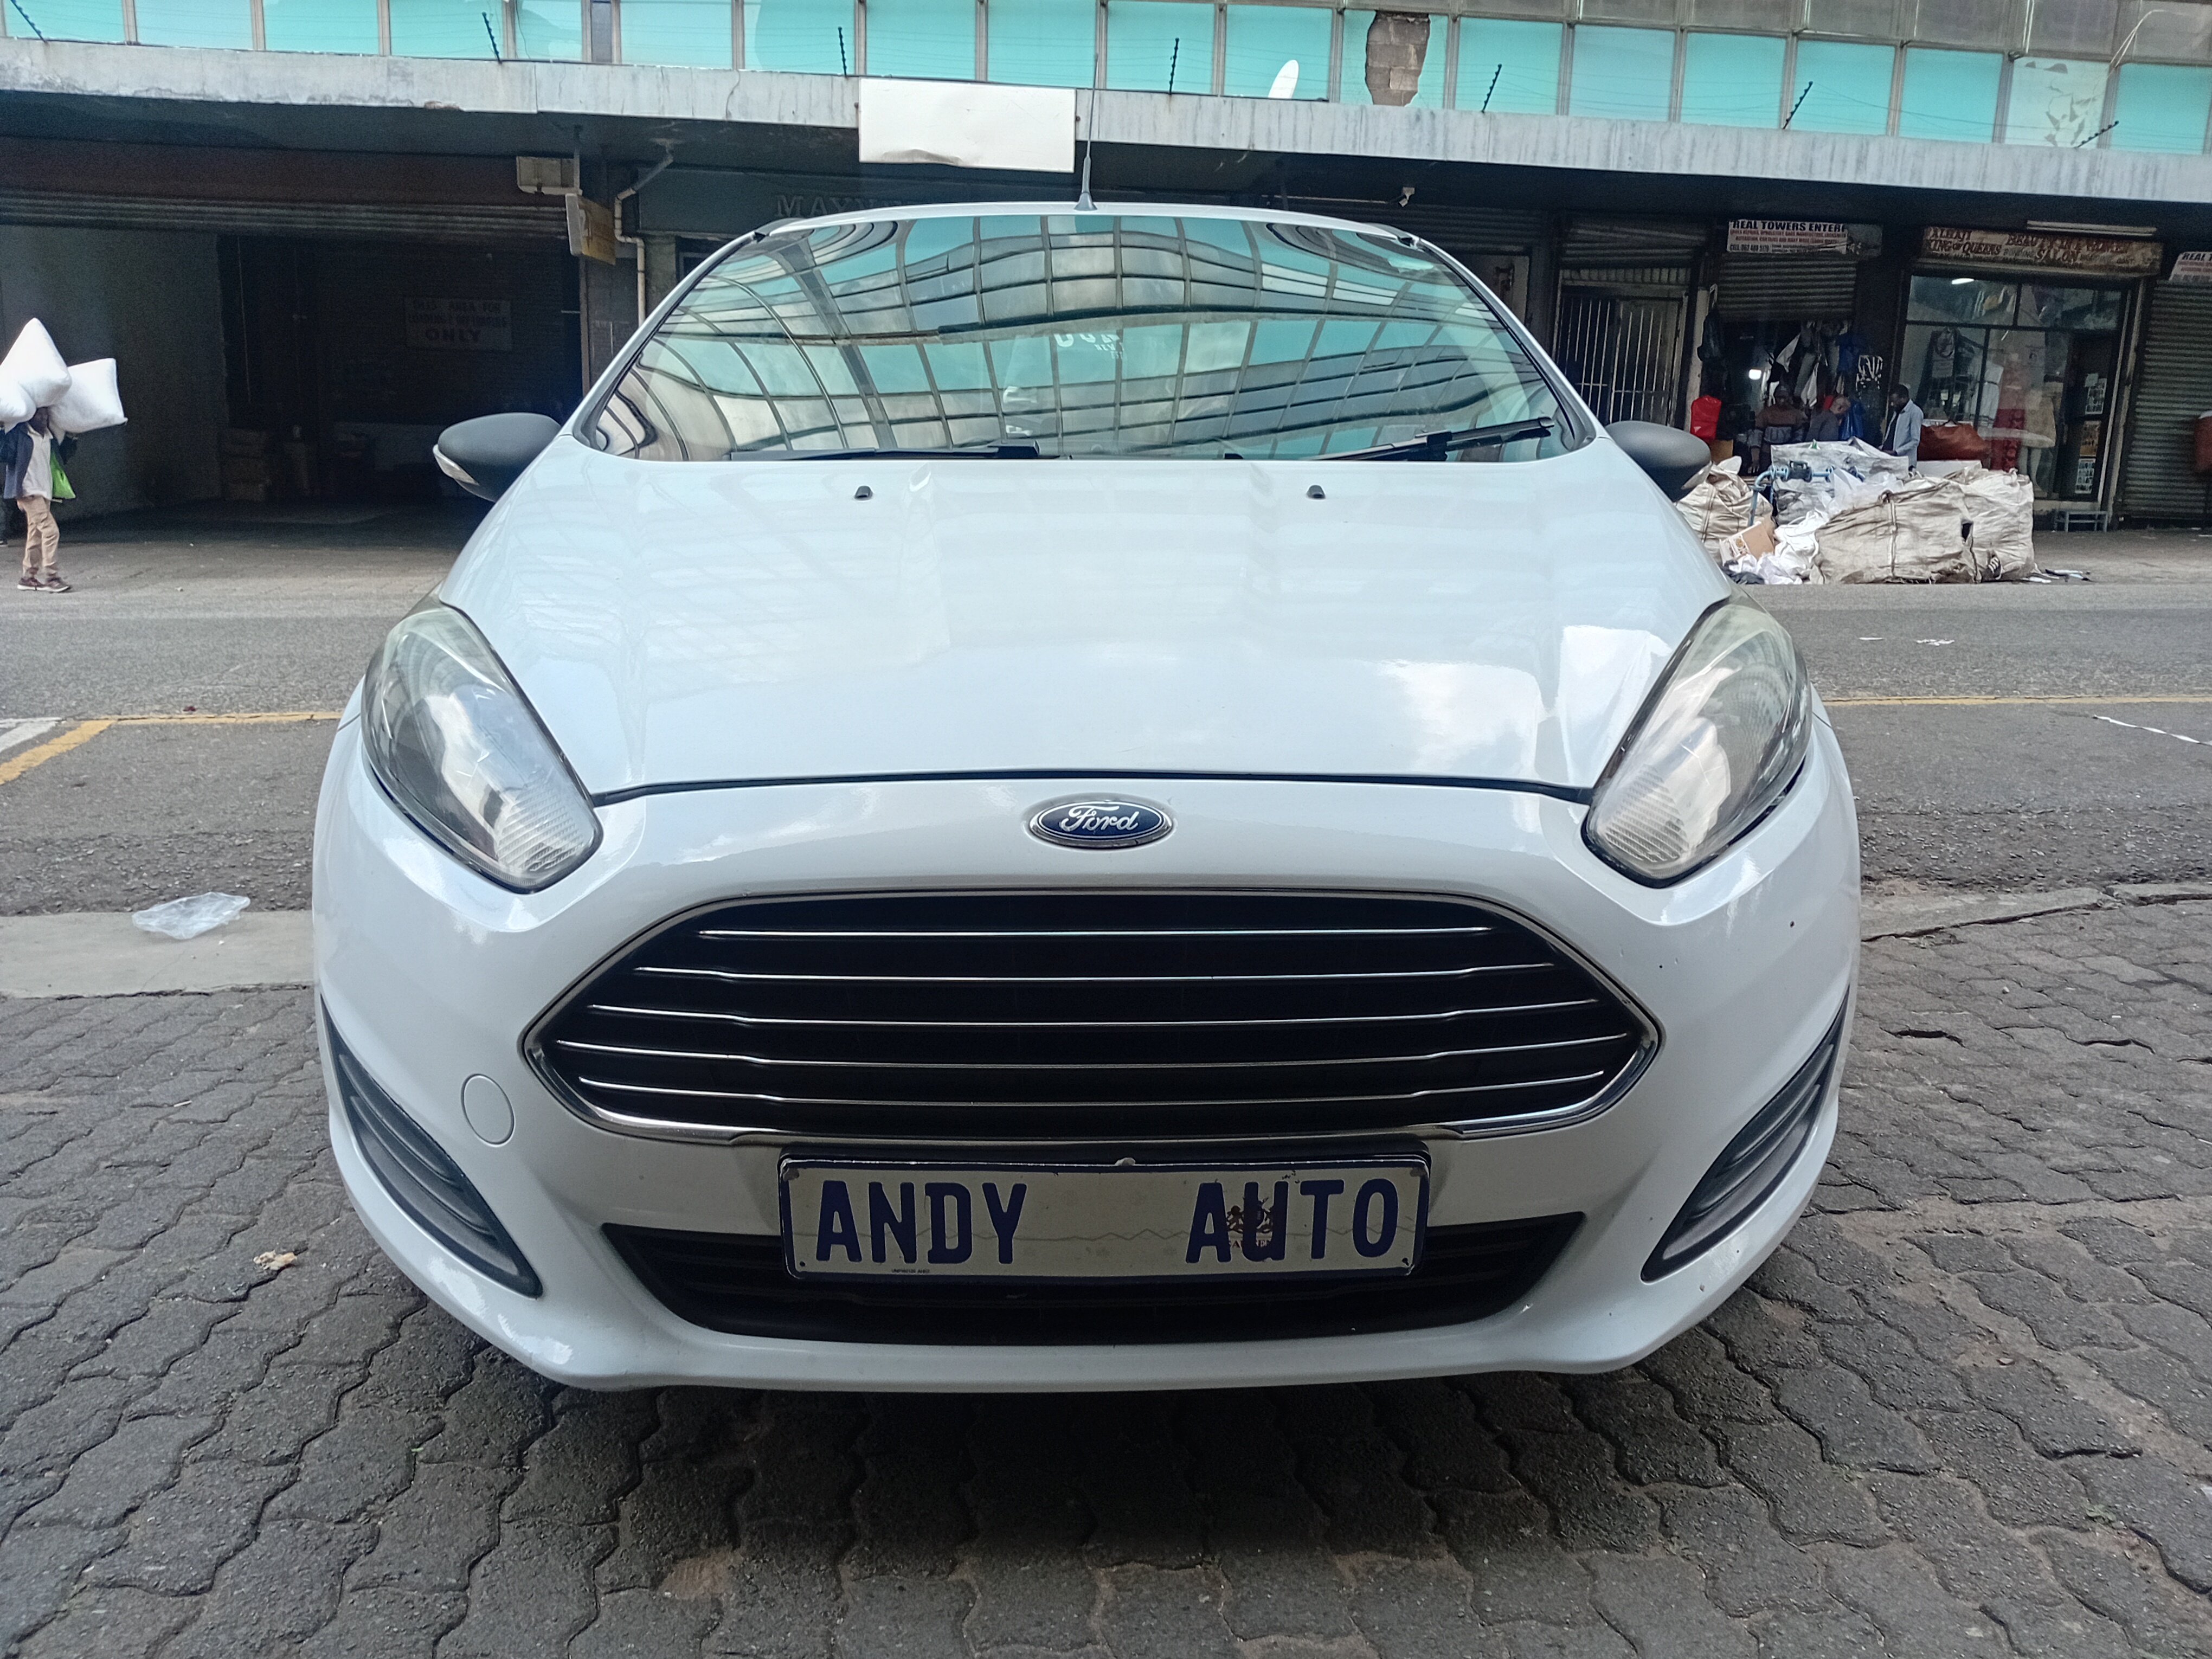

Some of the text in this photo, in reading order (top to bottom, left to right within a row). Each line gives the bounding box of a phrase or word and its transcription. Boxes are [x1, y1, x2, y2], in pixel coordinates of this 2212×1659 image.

[1733, 220, 1758, 229] REAL
[1762, 221, 1806, 232] TOWERS
[1963, 241, 2002, 256] QUEENS
[425, 328, 481, 343] ONLY
[1059, 806, 1139, 831] Ford
[816, 1178, 1398, 1264] ANDY AUTO
